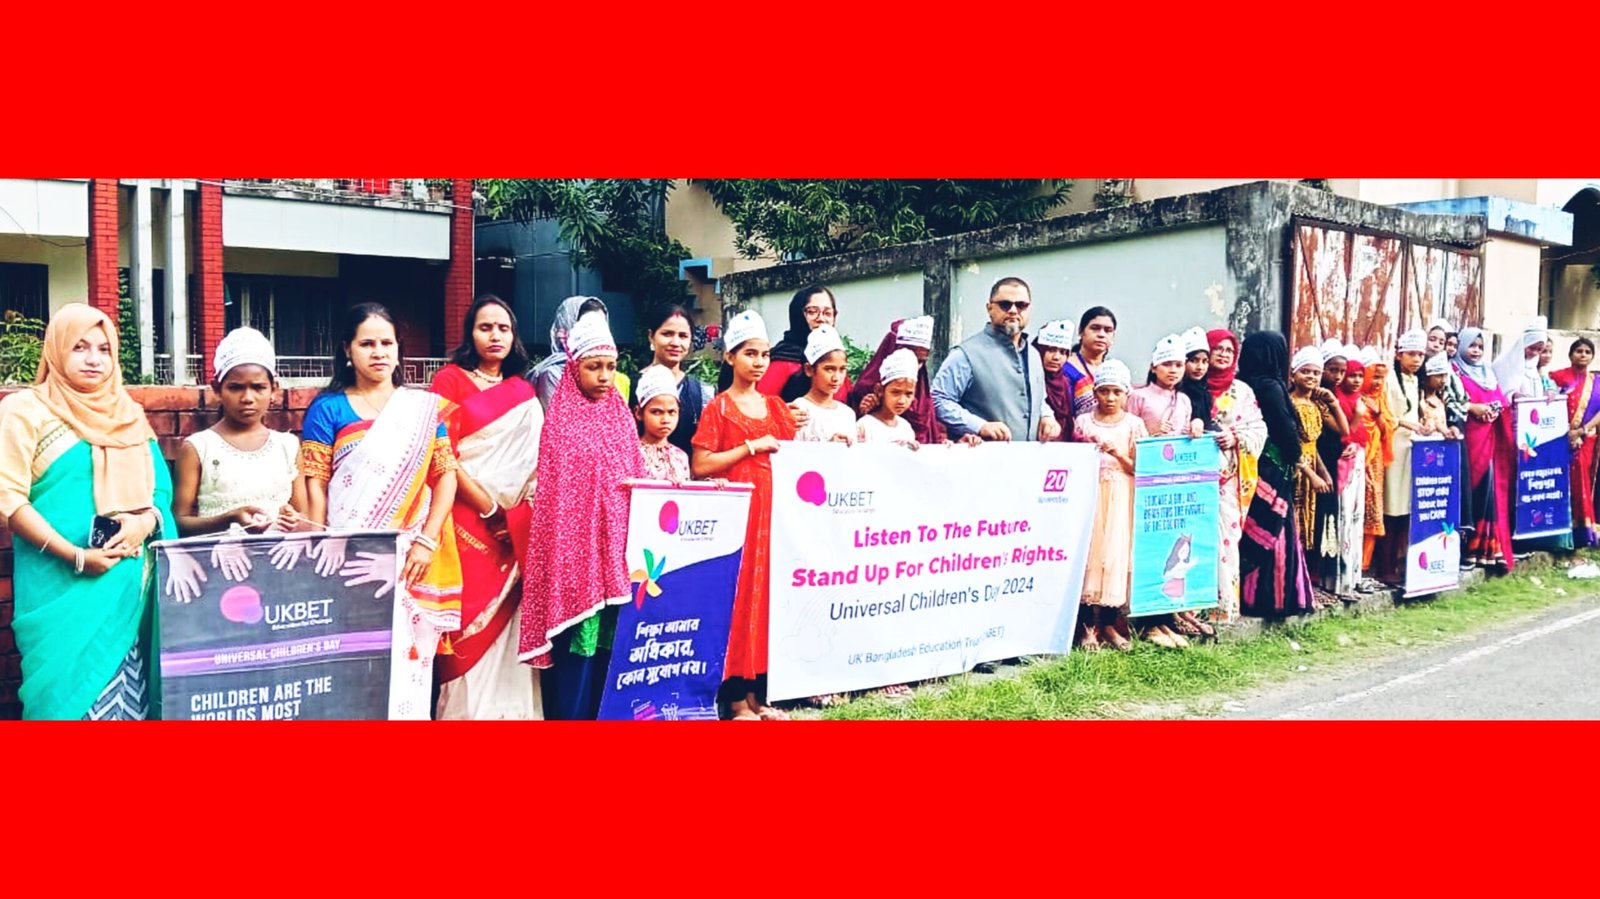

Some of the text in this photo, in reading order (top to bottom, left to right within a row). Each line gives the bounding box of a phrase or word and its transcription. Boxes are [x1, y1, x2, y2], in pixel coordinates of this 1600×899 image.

[1045, 471, 1066, 490] 20
[1417, 487, 1435, 498] STOP
[828, 491, 874, 507] UKBET
[679, 520, 718, 536] UKBET
[854, 520, 1032, 548] Listen To The Future.
[792, 565, 858, 588] Stand
[865, 564, 890, 585] Up
[896, 561, 924, 579] For
[1012, 545, 1068, 566] Rights.
[830, 594, 905, 621] Universal
[910, 586, 980, 612] Children's
[1002, 576, 1034, 594] 2024
[265, 599, 334, 624] UKBET
[635, 618, 700, 640] শিক্ষা আমার
[214, 639, 341, 665] UNIVERSAL CHILDREN'S DAY
[629, 638, 694, 662] অধিকার,
[848, 653, 863, 665] UK
[866, 644, 918, 664] Bangladesh
[919, 638, 962, 654] Education
[616, 668, 646, 690] কোন
[646, 662, 681, 685] সুযোগ
[191, 676, 332, 712] CHILDREN ARE THE
[261, 700, 302, 720] MOST
